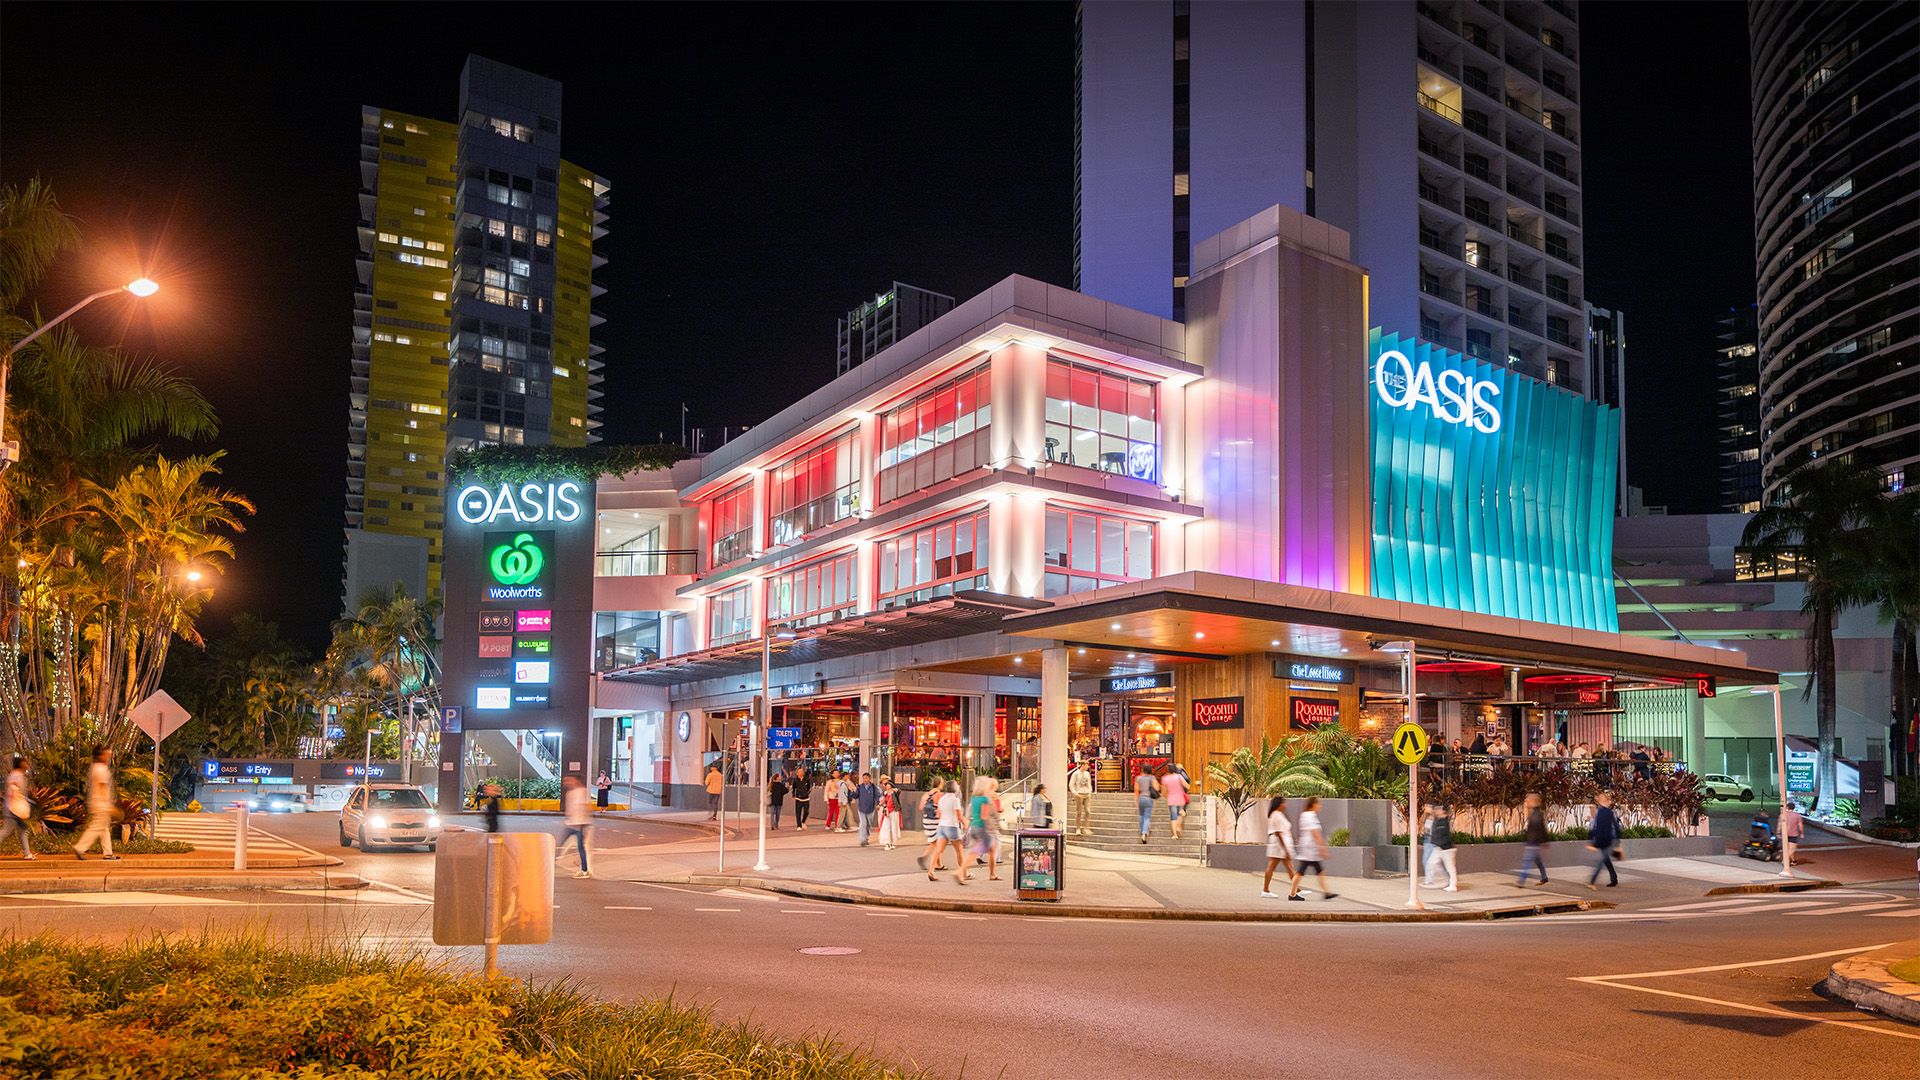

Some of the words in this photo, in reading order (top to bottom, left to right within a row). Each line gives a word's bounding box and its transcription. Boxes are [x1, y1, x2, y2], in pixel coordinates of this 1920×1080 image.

[1376, 350, 1500, 433] OASIS
[457, 482, 581, 524] OASIS
[490, 587, 542, 598] Woolworths
[1698, 679, 1713, 697] R
[446, 709, 457, 724] P
[208, 763, 216, 775] P
[254, 766, 272, 776] Entry
[355, 767, 365, 775] No
[367, 767, 385, 776] Entry
